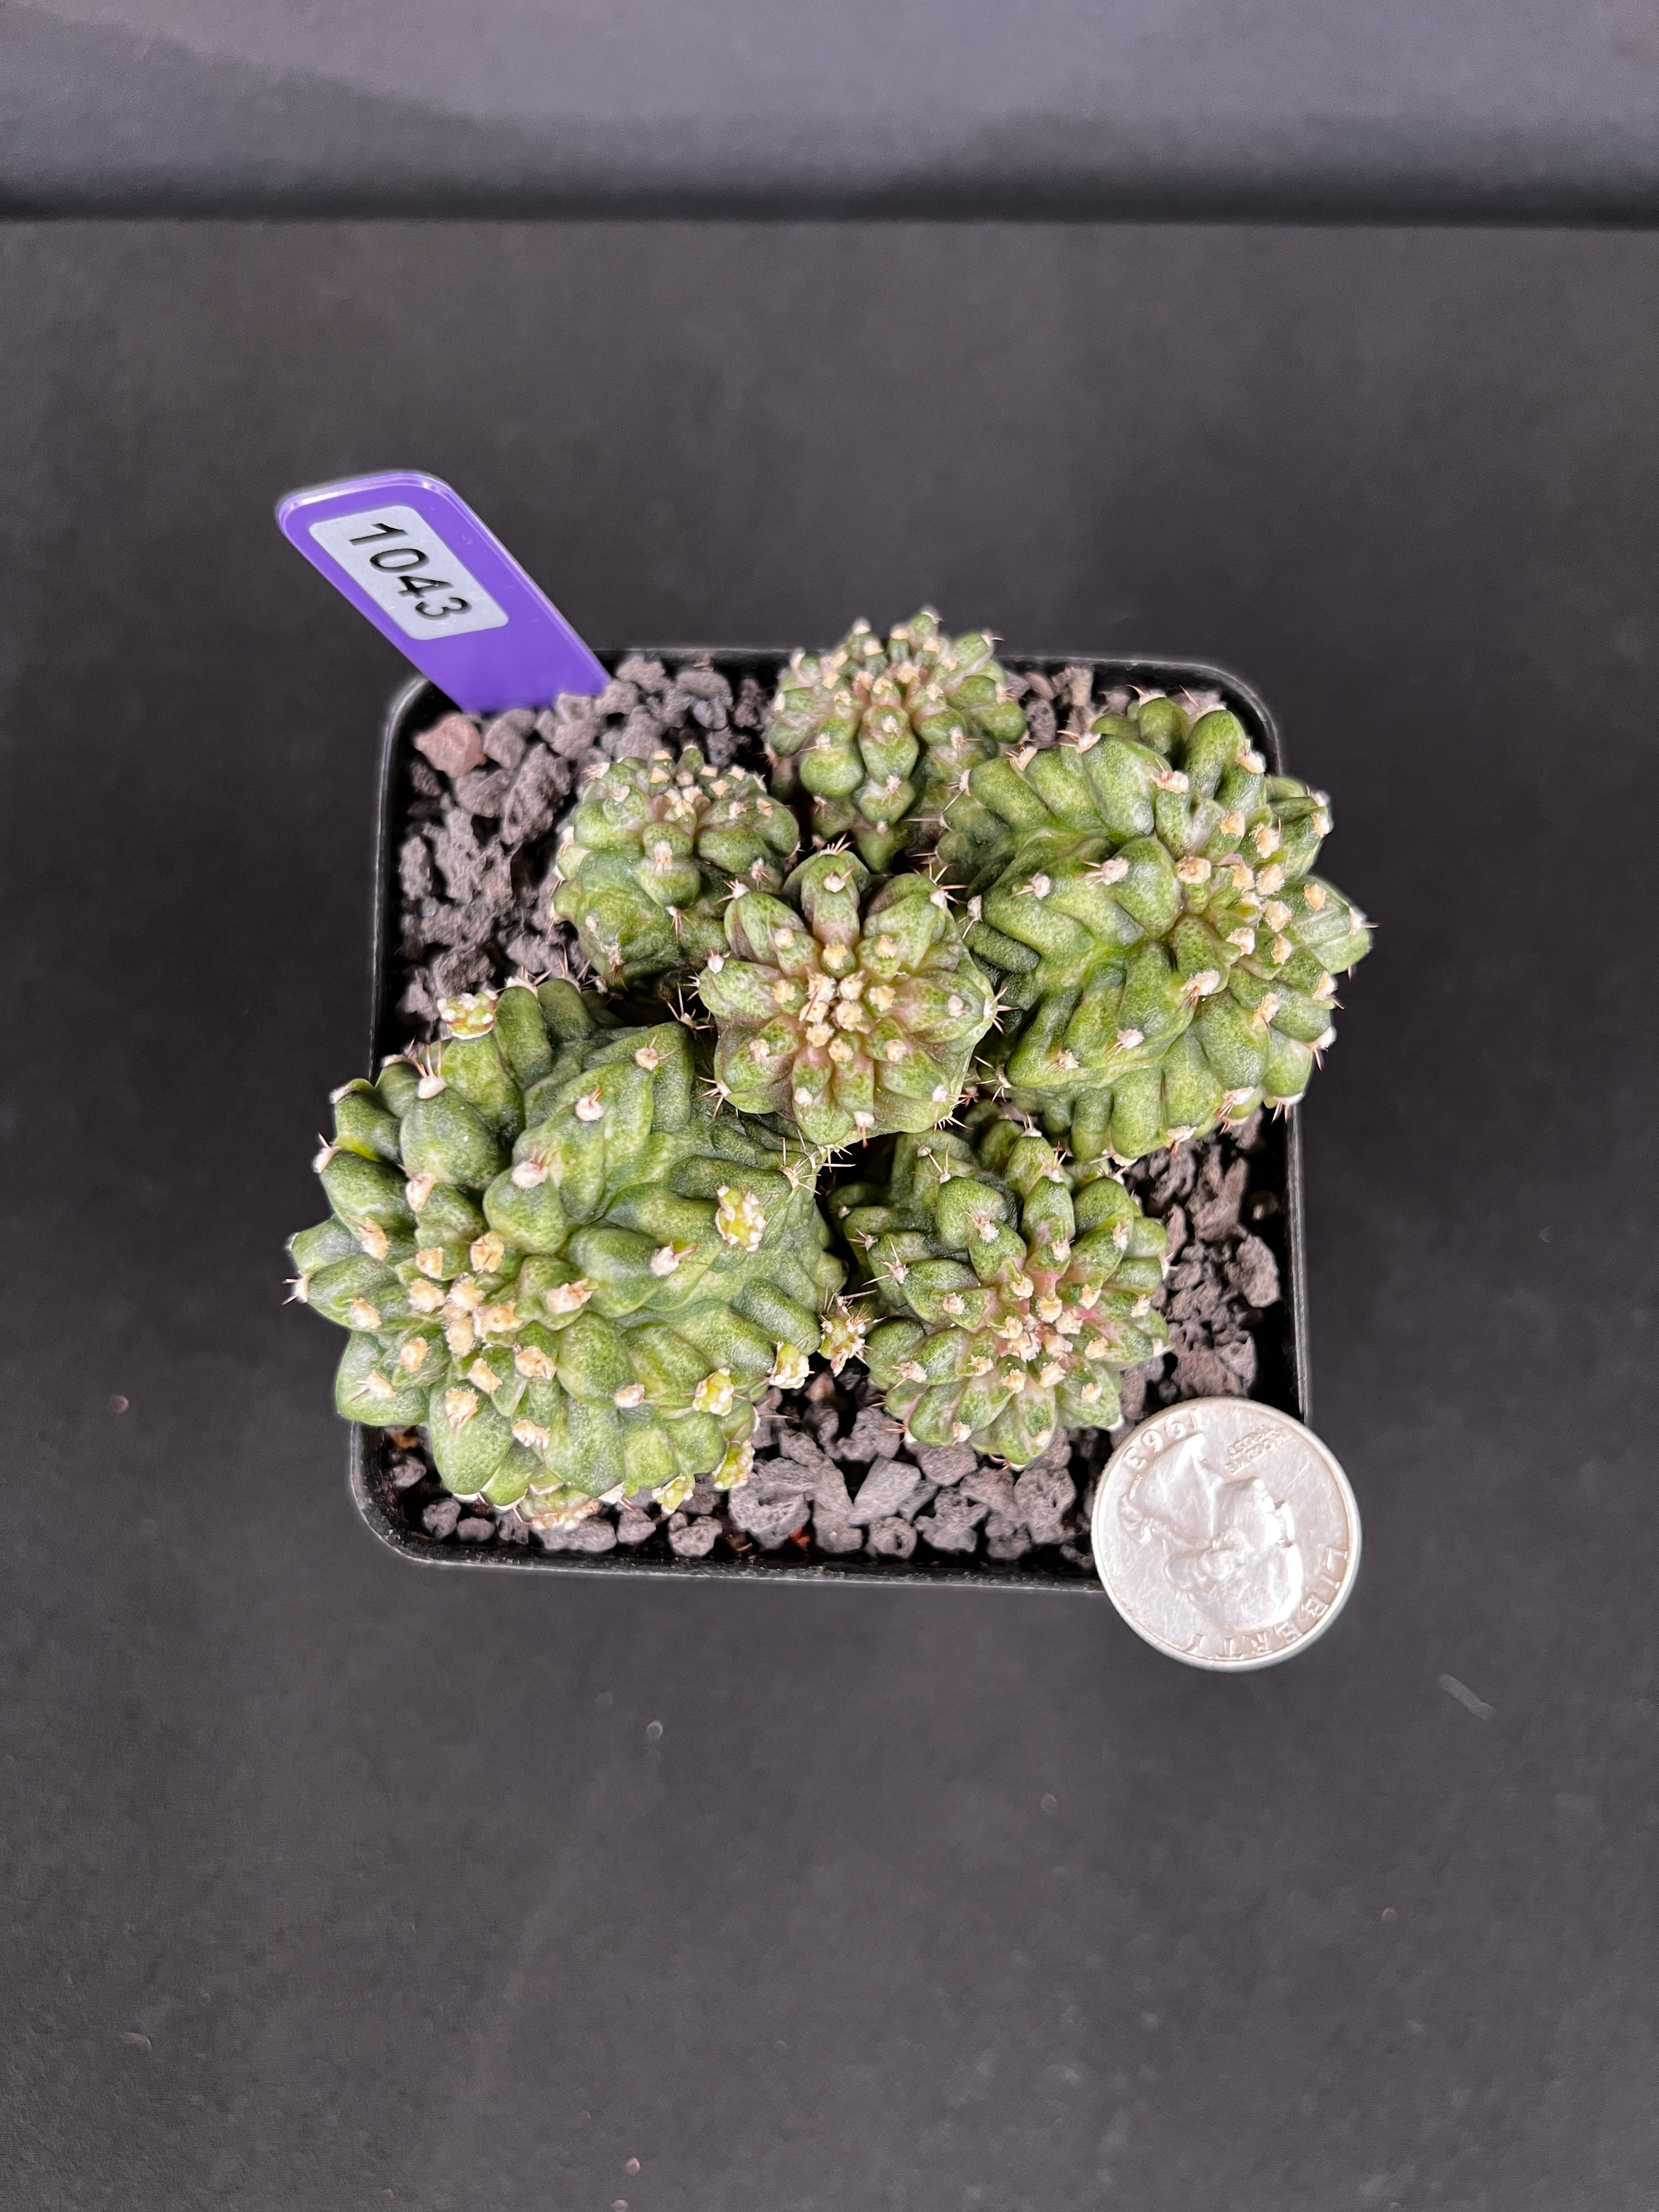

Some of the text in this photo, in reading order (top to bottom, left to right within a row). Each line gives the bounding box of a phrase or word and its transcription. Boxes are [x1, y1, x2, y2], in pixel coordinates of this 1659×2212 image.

[348, 522, 472, 621] 1043
[1122, 1407, 1207, 1470] 1963
[1184, 1545, 1349, 1660] LIBERTY
